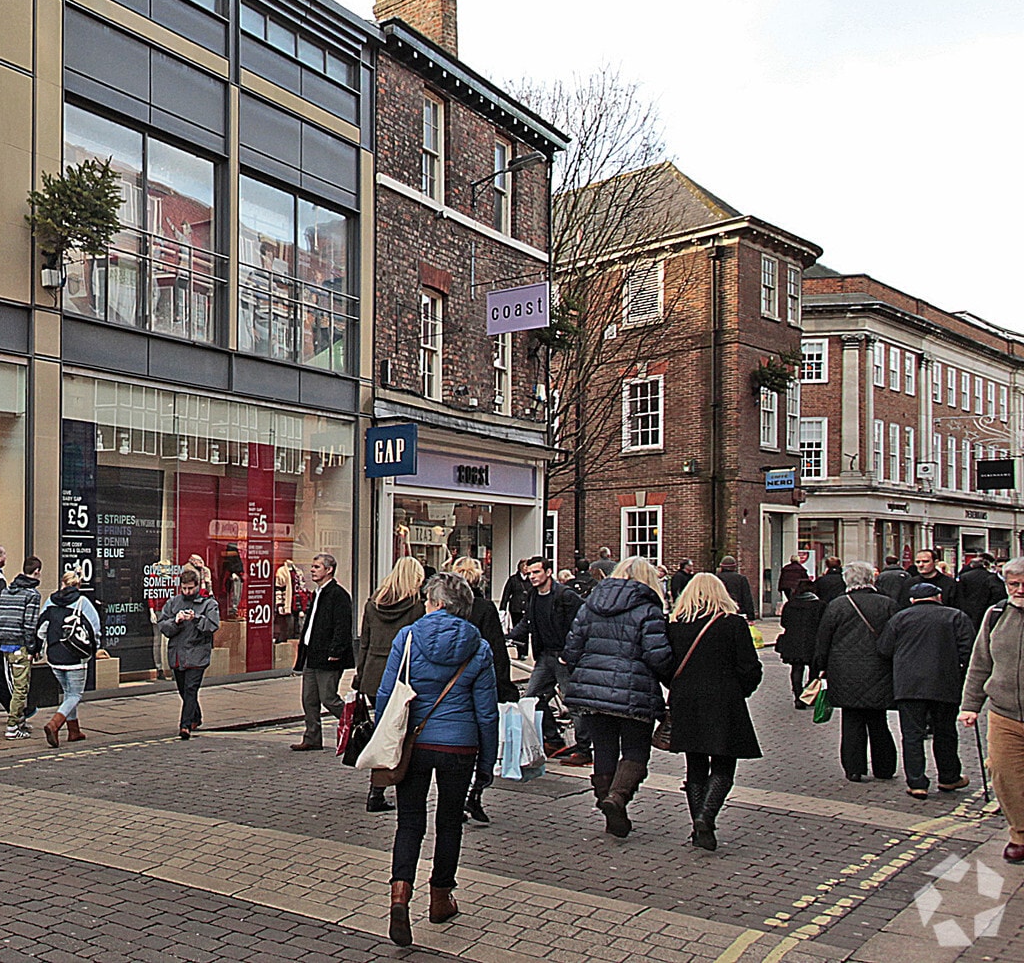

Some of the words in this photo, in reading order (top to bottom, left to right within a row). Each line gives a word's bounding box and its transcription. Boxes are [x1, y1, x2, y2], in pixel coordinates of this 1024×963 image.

[491, 296, 543, 321] coast
[374, 439, 405, 464] GAP
[68, 505, 89, 529] £5
[104, 514, 136, 525] STRIPES
[252, 514, 268, 535] £5
[104, 526, 132, 536] PRINTS
[104, 537, 129, 547] DENIM
[104, 548, 125, 558] BLUE
[143, 565, 162, 576] GIVE
[249, 559, 271, 579] £10
[143, 588, 175, 599] FESTIVE
[248, 604, 271, 625] £20
